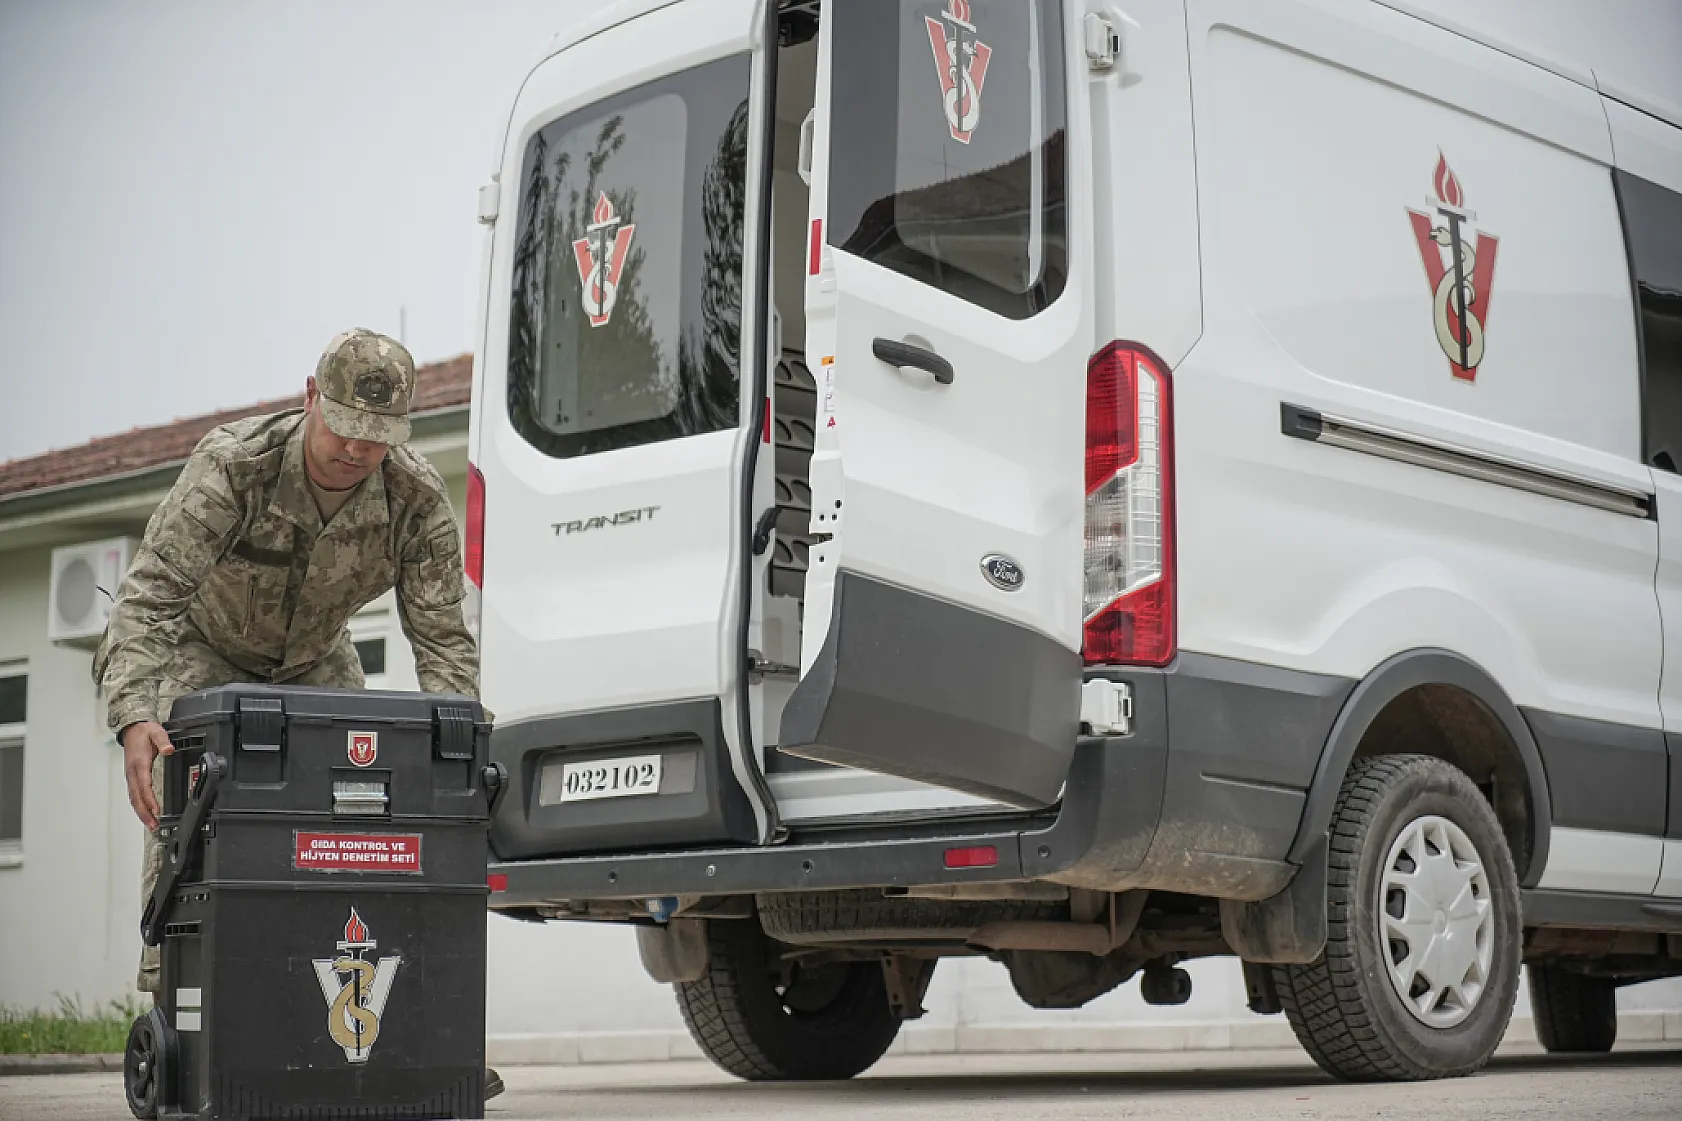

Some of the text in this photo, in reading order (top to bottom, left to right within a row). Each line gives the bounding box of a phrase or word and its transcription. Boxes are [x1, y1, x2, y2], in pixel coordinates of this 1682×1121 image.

[551, 504, 661, 536] TRANSIT
[565, 763, 656, 794] 032102
[300, 849, 339, 861] HİJYEN
[391, 852, 415, 864] SETİ
[340, 840, 389, 851] KONTROL
[391, 842, 406, 851] VE
